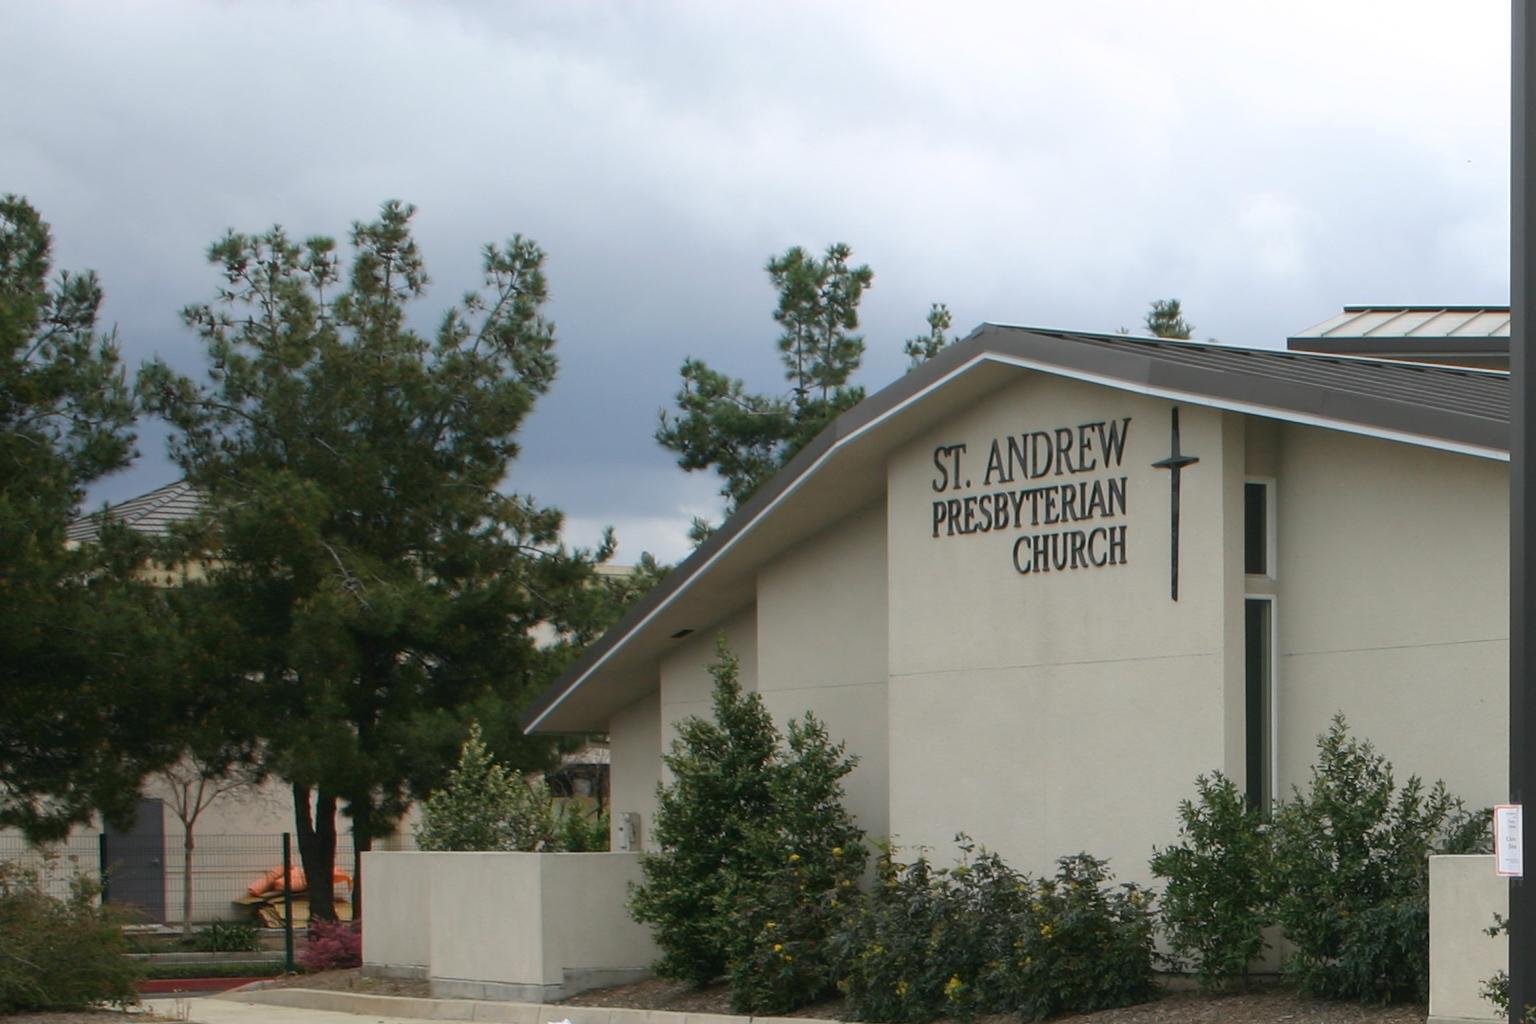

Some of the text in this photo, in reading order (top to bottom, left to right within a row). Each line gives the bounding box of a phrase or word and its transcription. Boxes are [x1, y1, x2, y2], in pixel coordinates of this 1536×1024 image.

[932, 417, 1132, 492] ST. ANDREW
[932, 477, 1128, 537] PRESBYTERIAN
[1012, 525, 1128, 574] CHURCH
